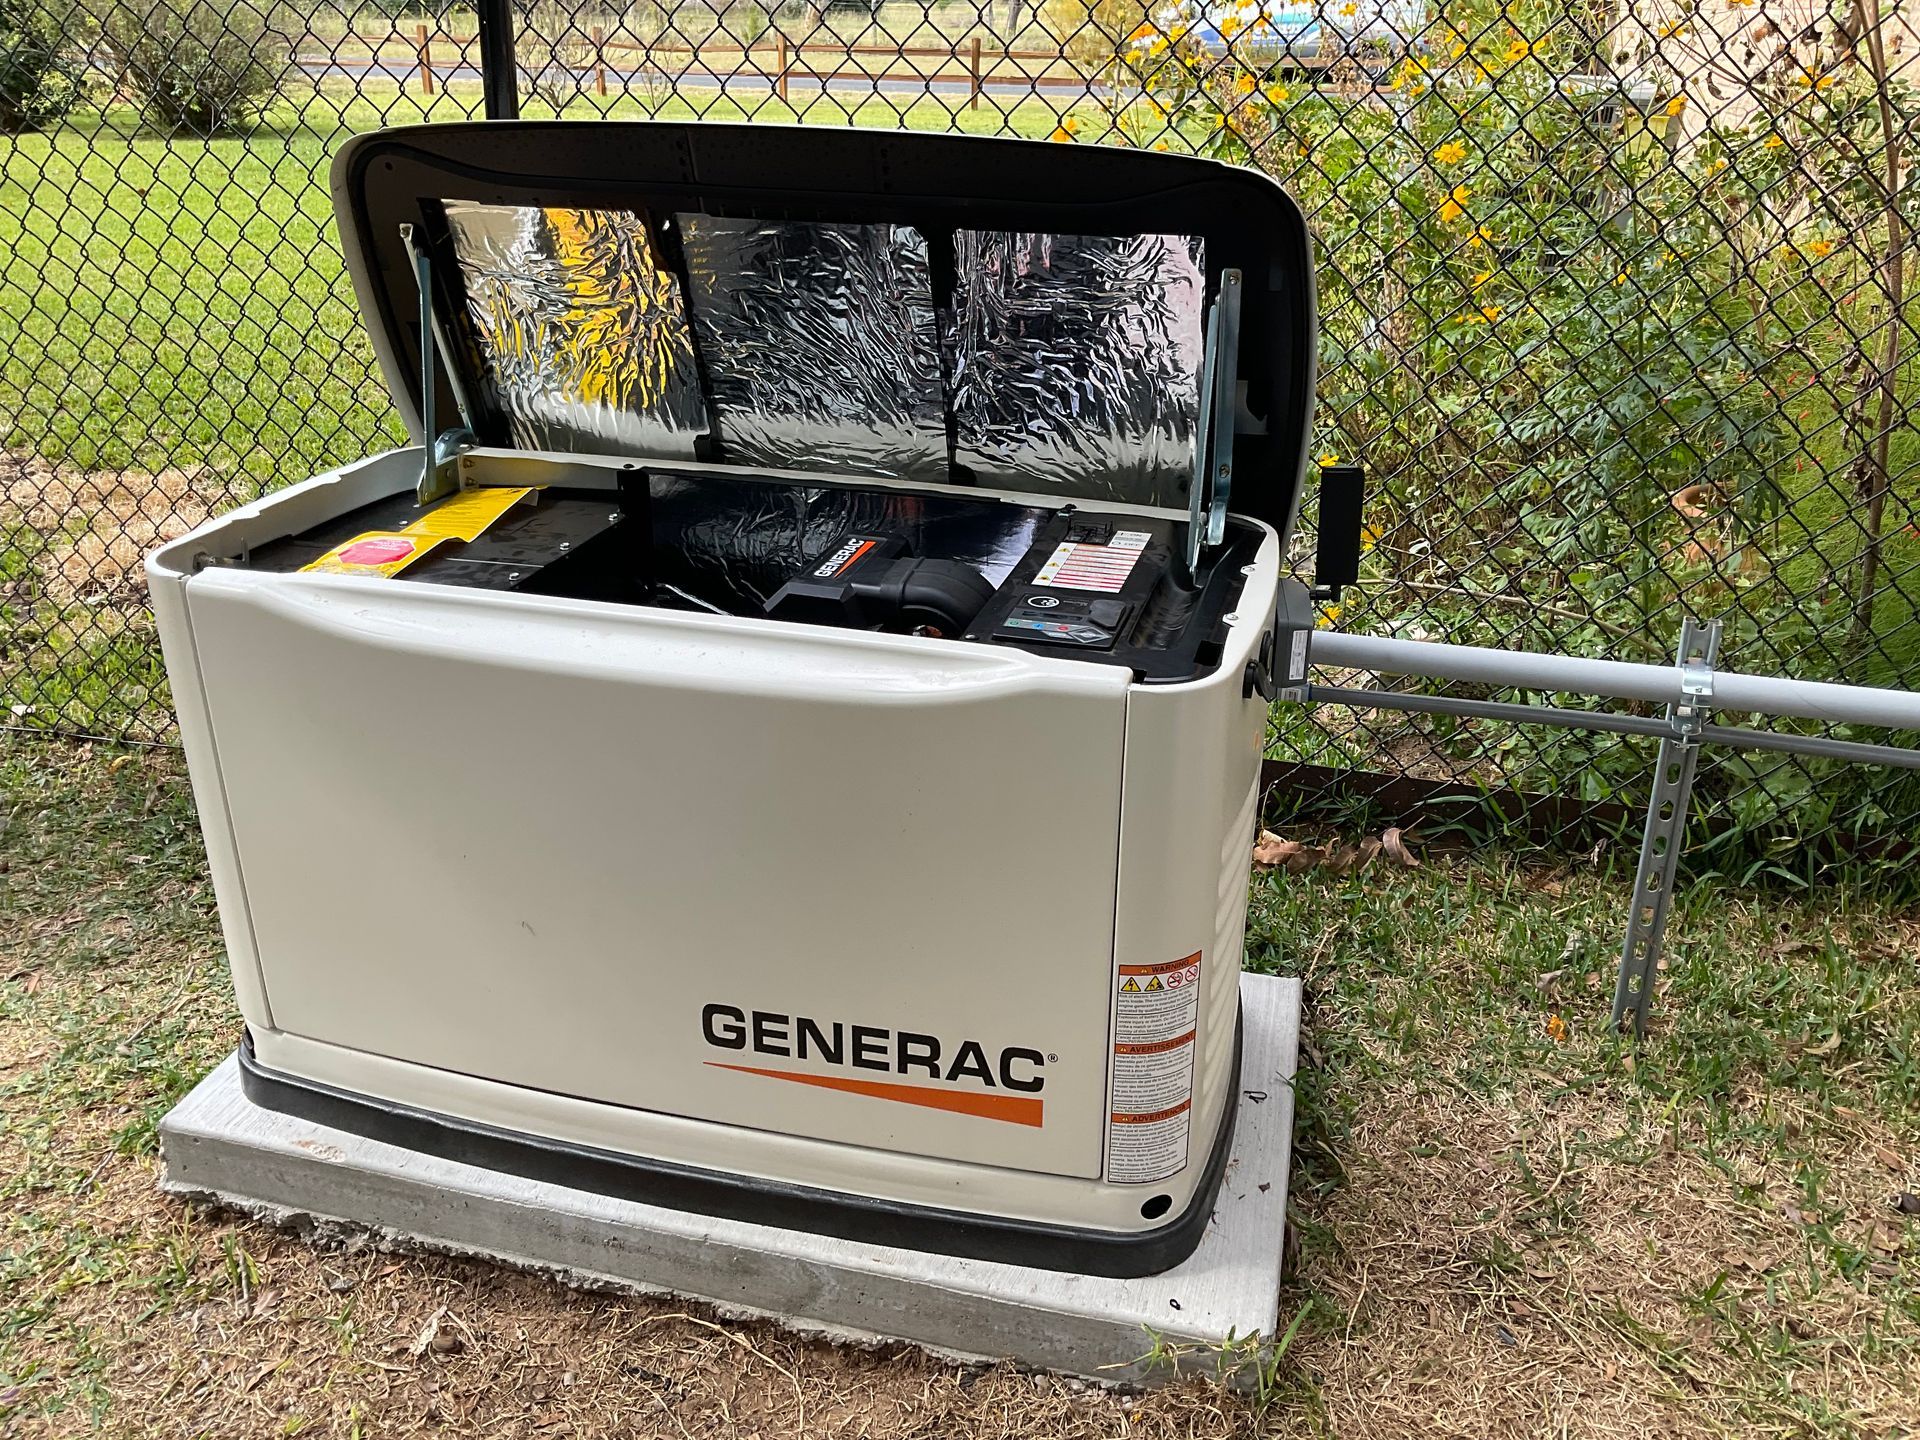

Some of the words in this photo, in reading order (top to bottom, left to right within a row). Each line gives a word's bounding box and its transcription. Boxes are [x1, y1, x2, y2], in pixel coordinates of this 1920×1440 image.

[814, 538, 865, 577] GENERAC
[1151, 959, 1189, 973] WARNING
[1129, 1033, 1193, 1052] AVERTISSEMENT
[1132, 1104, 1186, 1121] ADVERTENCIA
